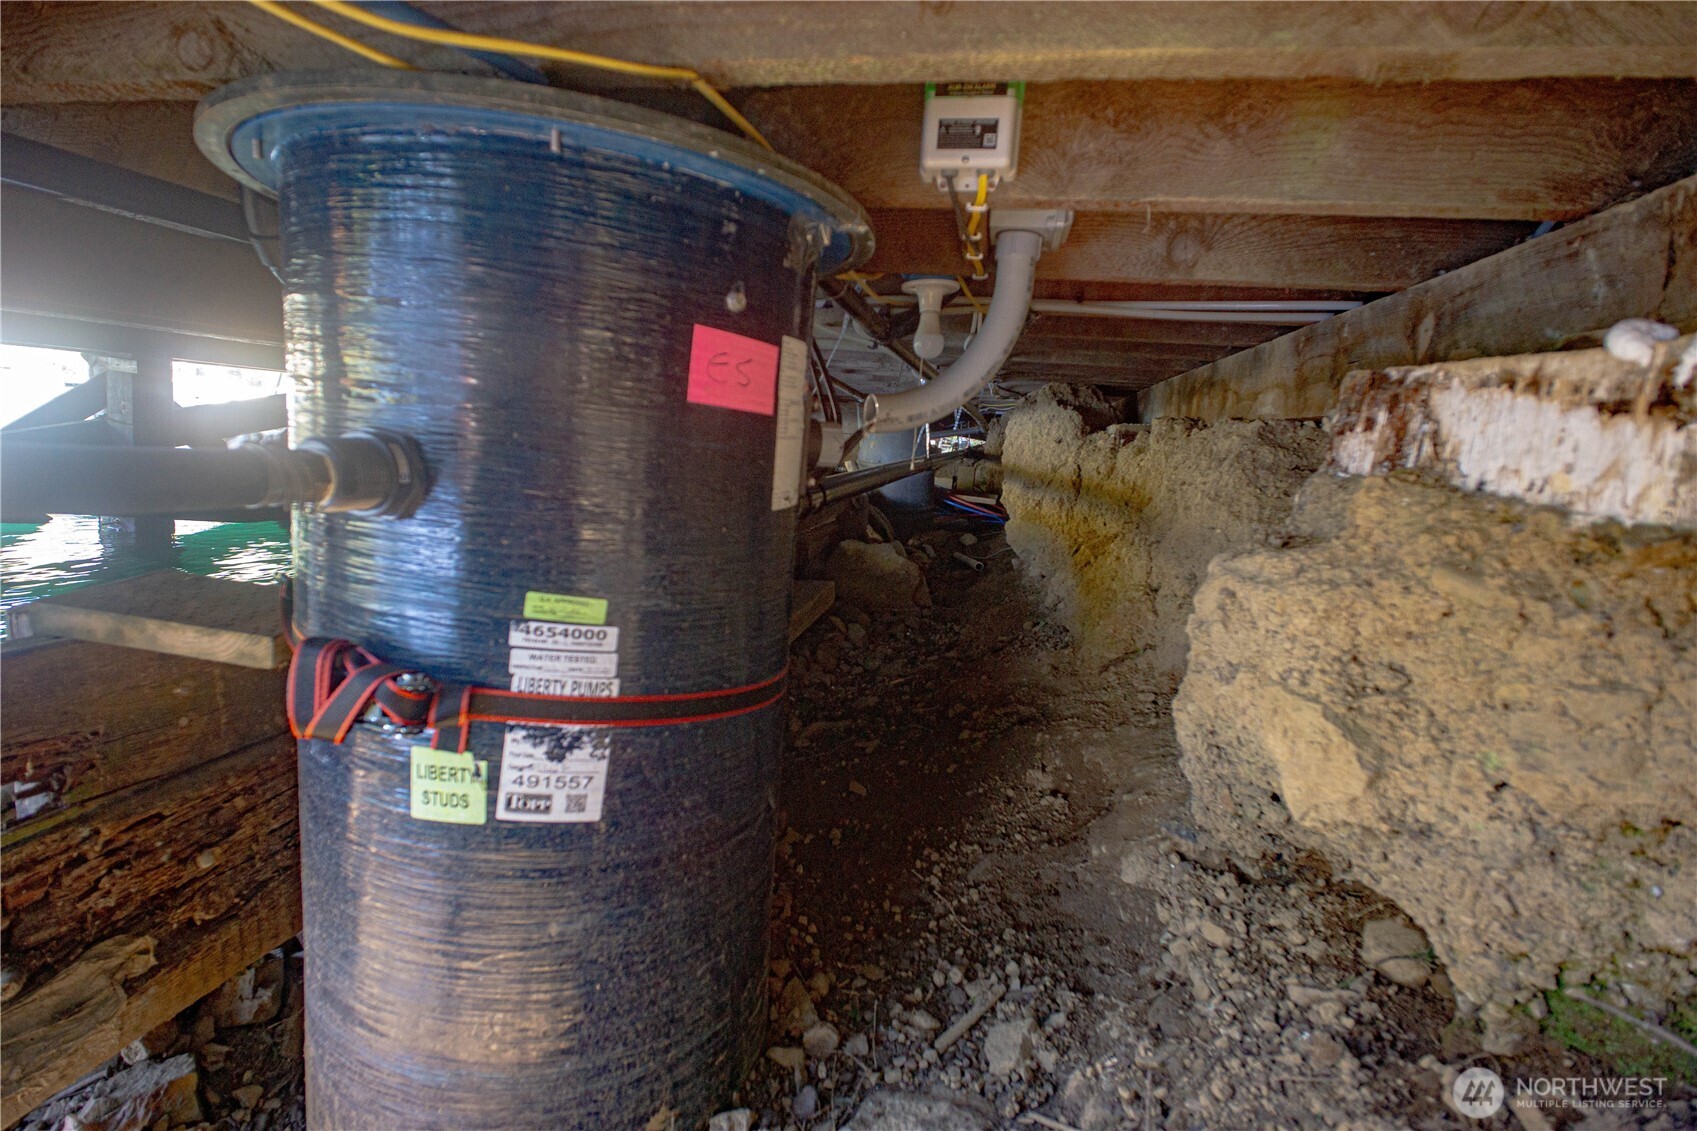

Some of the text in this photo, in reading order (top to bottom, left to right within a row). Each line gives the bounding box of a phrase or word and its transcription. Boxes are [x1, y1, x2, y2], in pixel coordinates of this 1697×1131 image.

[528, 653, 597, 664] WATER TESTED
[517, 675, 614, 698] LIBERTY PUMPS
[511, 774, 595, 790] 491557
[421, 790, 470, 809] STUDS
